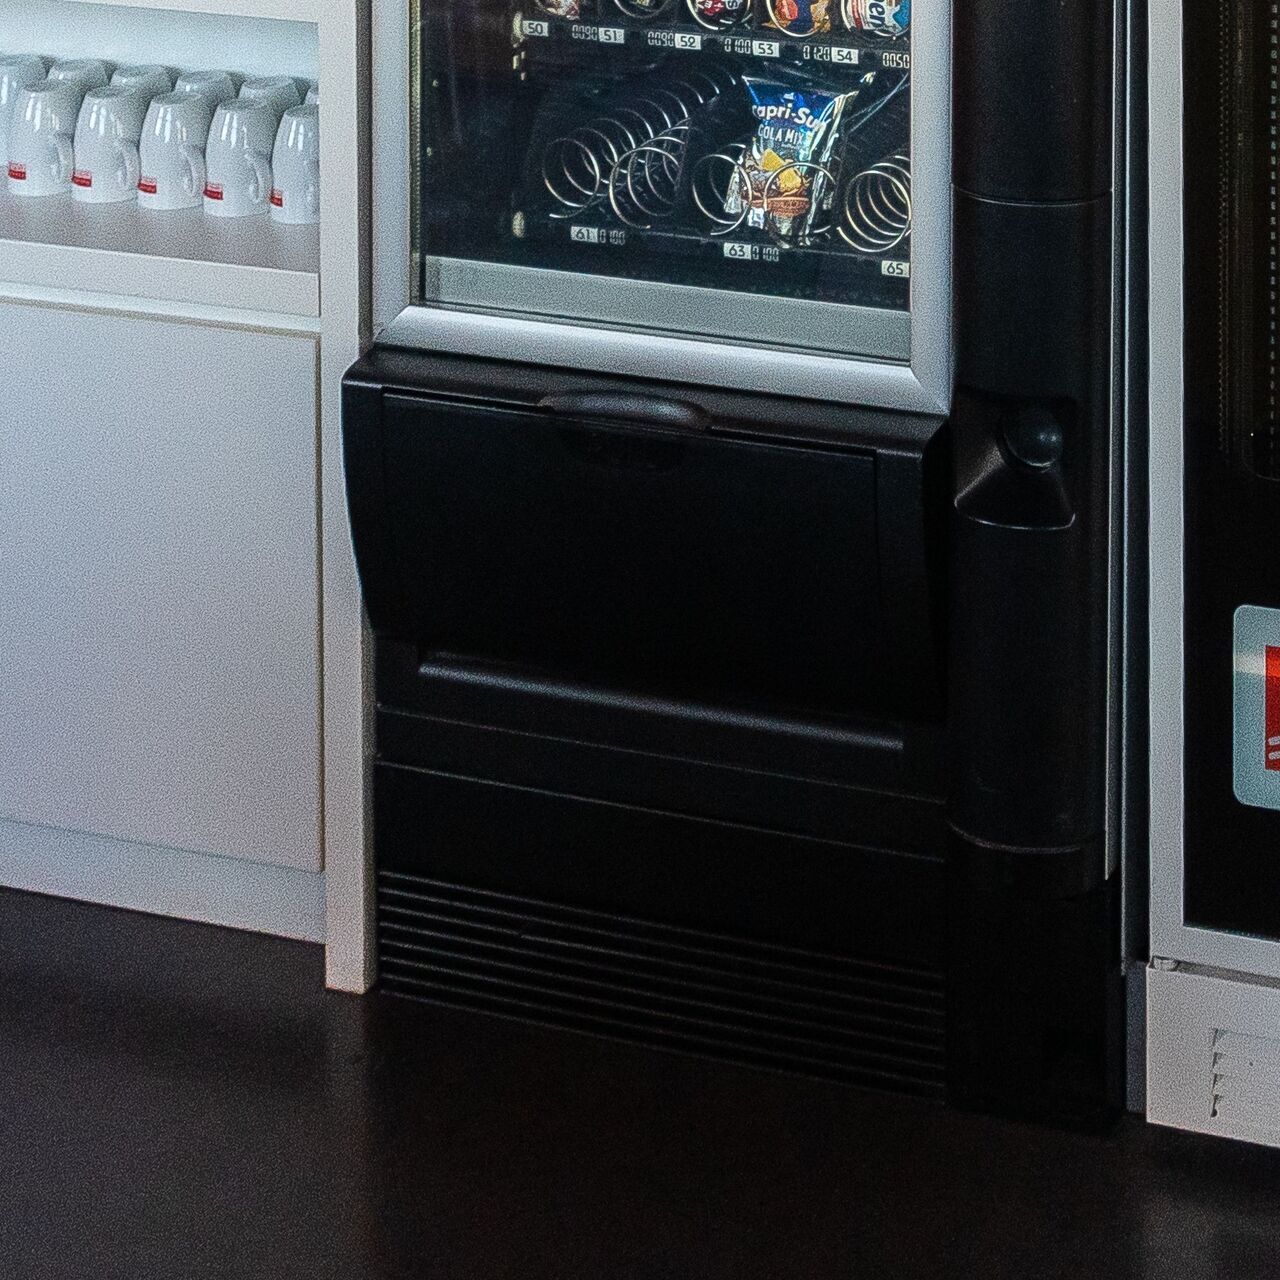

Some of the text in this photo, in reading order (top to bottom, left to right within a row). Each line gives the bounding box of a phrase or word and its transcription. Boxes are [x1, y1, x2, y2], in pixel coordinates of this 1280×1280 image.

[527, 23, 543, 35] 50
[603, 28, 618, 41] 51
[680, 35, 696, 48] 52
[758, 42, 774, 55] 53
[837, 49, 853, 62] 54
[757, 124, 805, 145] COLA MIX
[728, 245, 745, 258] 63
[886, 262, 903, 275] 65
